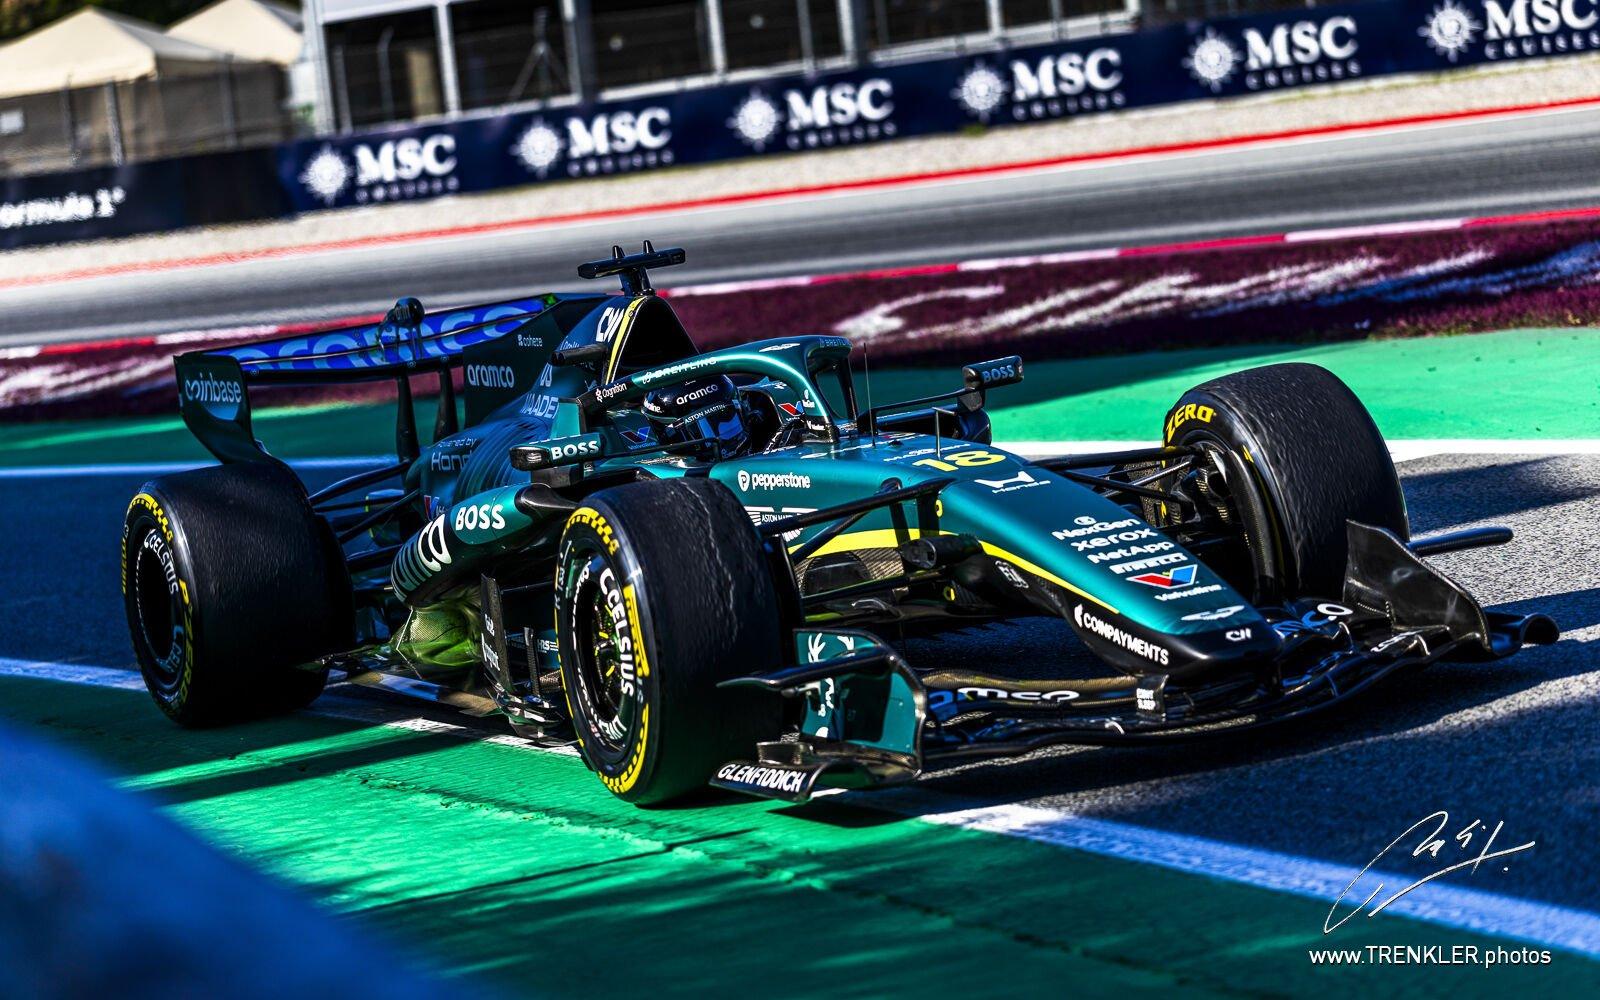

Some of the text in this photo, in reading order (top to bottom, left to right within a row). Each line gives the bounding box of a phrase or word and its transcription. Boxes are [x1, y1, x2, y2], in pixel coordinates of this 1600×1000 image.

[1482, 0, 1598, 40] MSC
[1242, 16, 1358, 70] MSC
[1009, 47, 1123, 101] MSC
[785, 79, 894, 131] MSC
[567, 107, 672, 159] MSC
[354, 134, 458, 186] MSC
[467, 363, 515, 388] aramco
[982, 364, 1015, 382] BOSS
[185, 372, 242, 403] coinbase
[676, 384, 718, 405] aramco
[685, 403, 726, 425] ASTON MARTIN
[1166, 403, 1214, 443] ZERO
[551, 440, 600, 461] BOSS
[912, 450, 1006, 472] 18
[752, 471, 811, 490] pepperstone
[456, 504, 506, 531] BOSS
[1052, 518, 1141, 540] NexGen
[1071, 528, 1158, 551] xerox
[1087, 541, 1175, 563] NetApp
[1083, 614, 1169, 665] COINPAYMENTS
[717, 763, 807, 793] GLENFIDDICH
